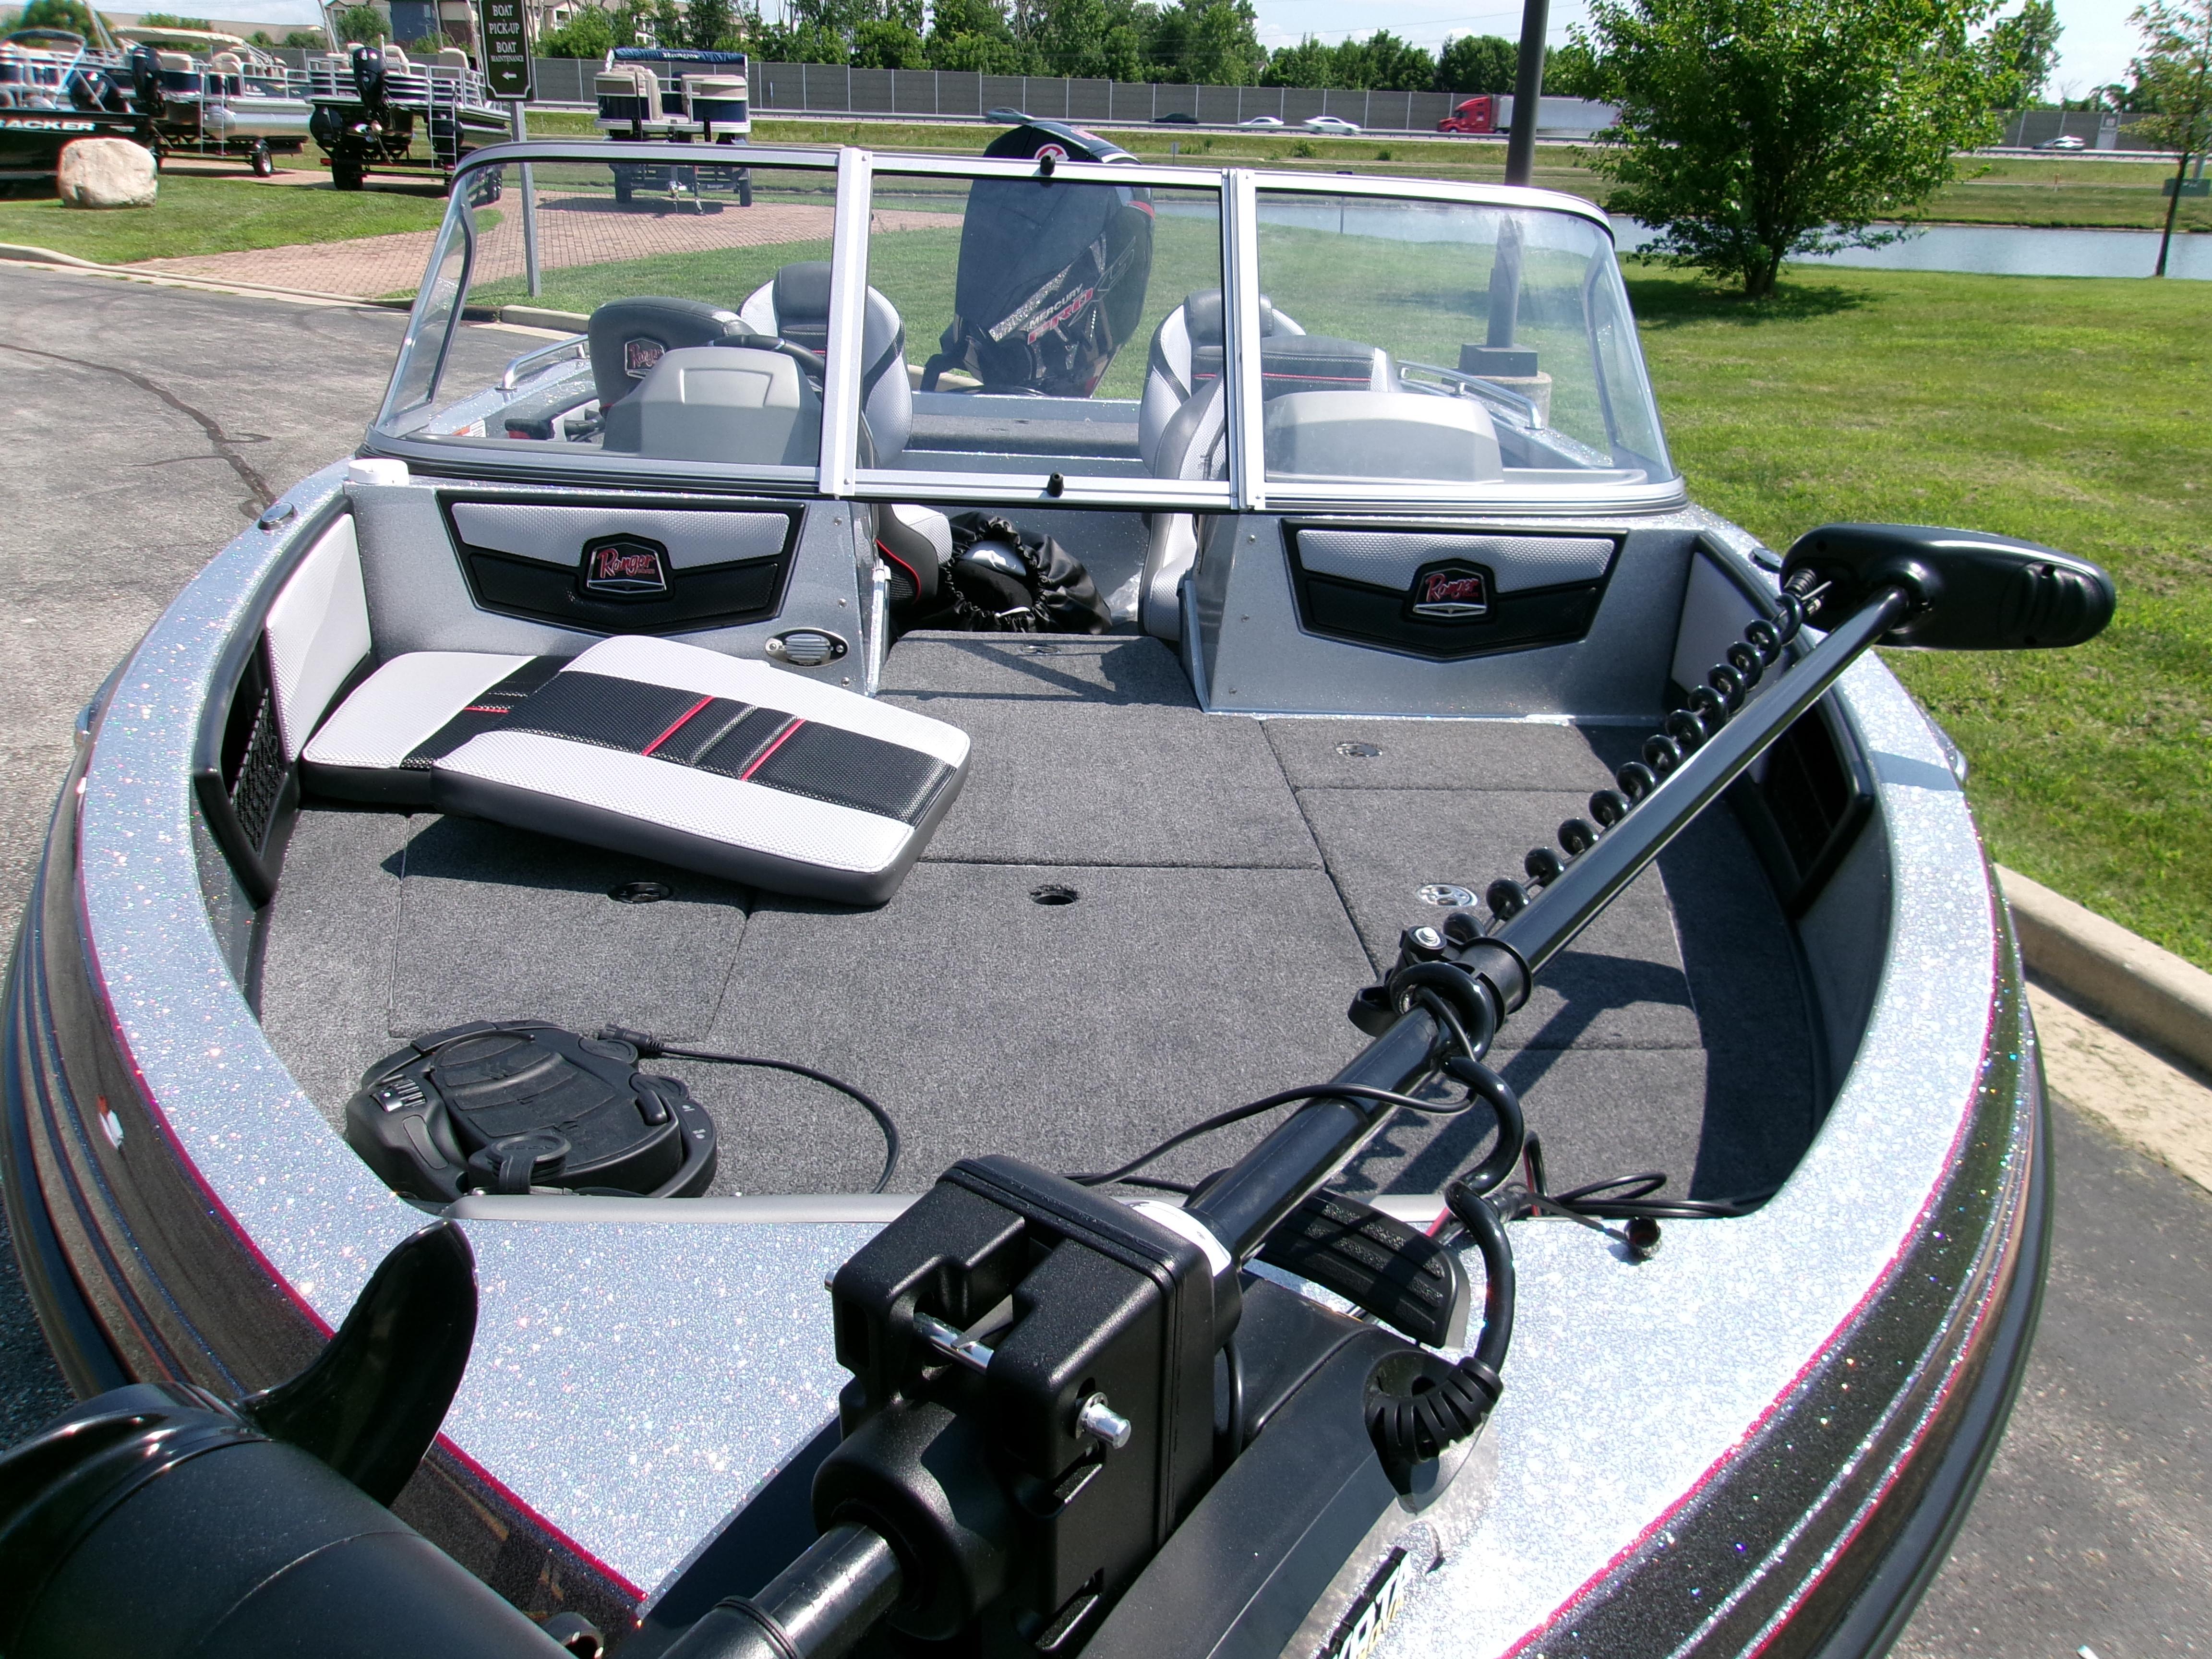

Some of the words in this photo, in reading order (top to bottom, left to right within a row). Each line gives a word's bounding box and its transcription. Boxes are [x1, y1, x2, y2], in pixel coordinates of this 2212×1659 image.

[492, 5, 514, 17] BOAT
[489, 23, 520, 35] PICK-UP
[496, 41, 517, 53] BOAT
[1029, 283, 1083, 329] MERCURY
[597, 548, 656, 578] Ranger
[1425, 573, 1479, 602] Ranger
